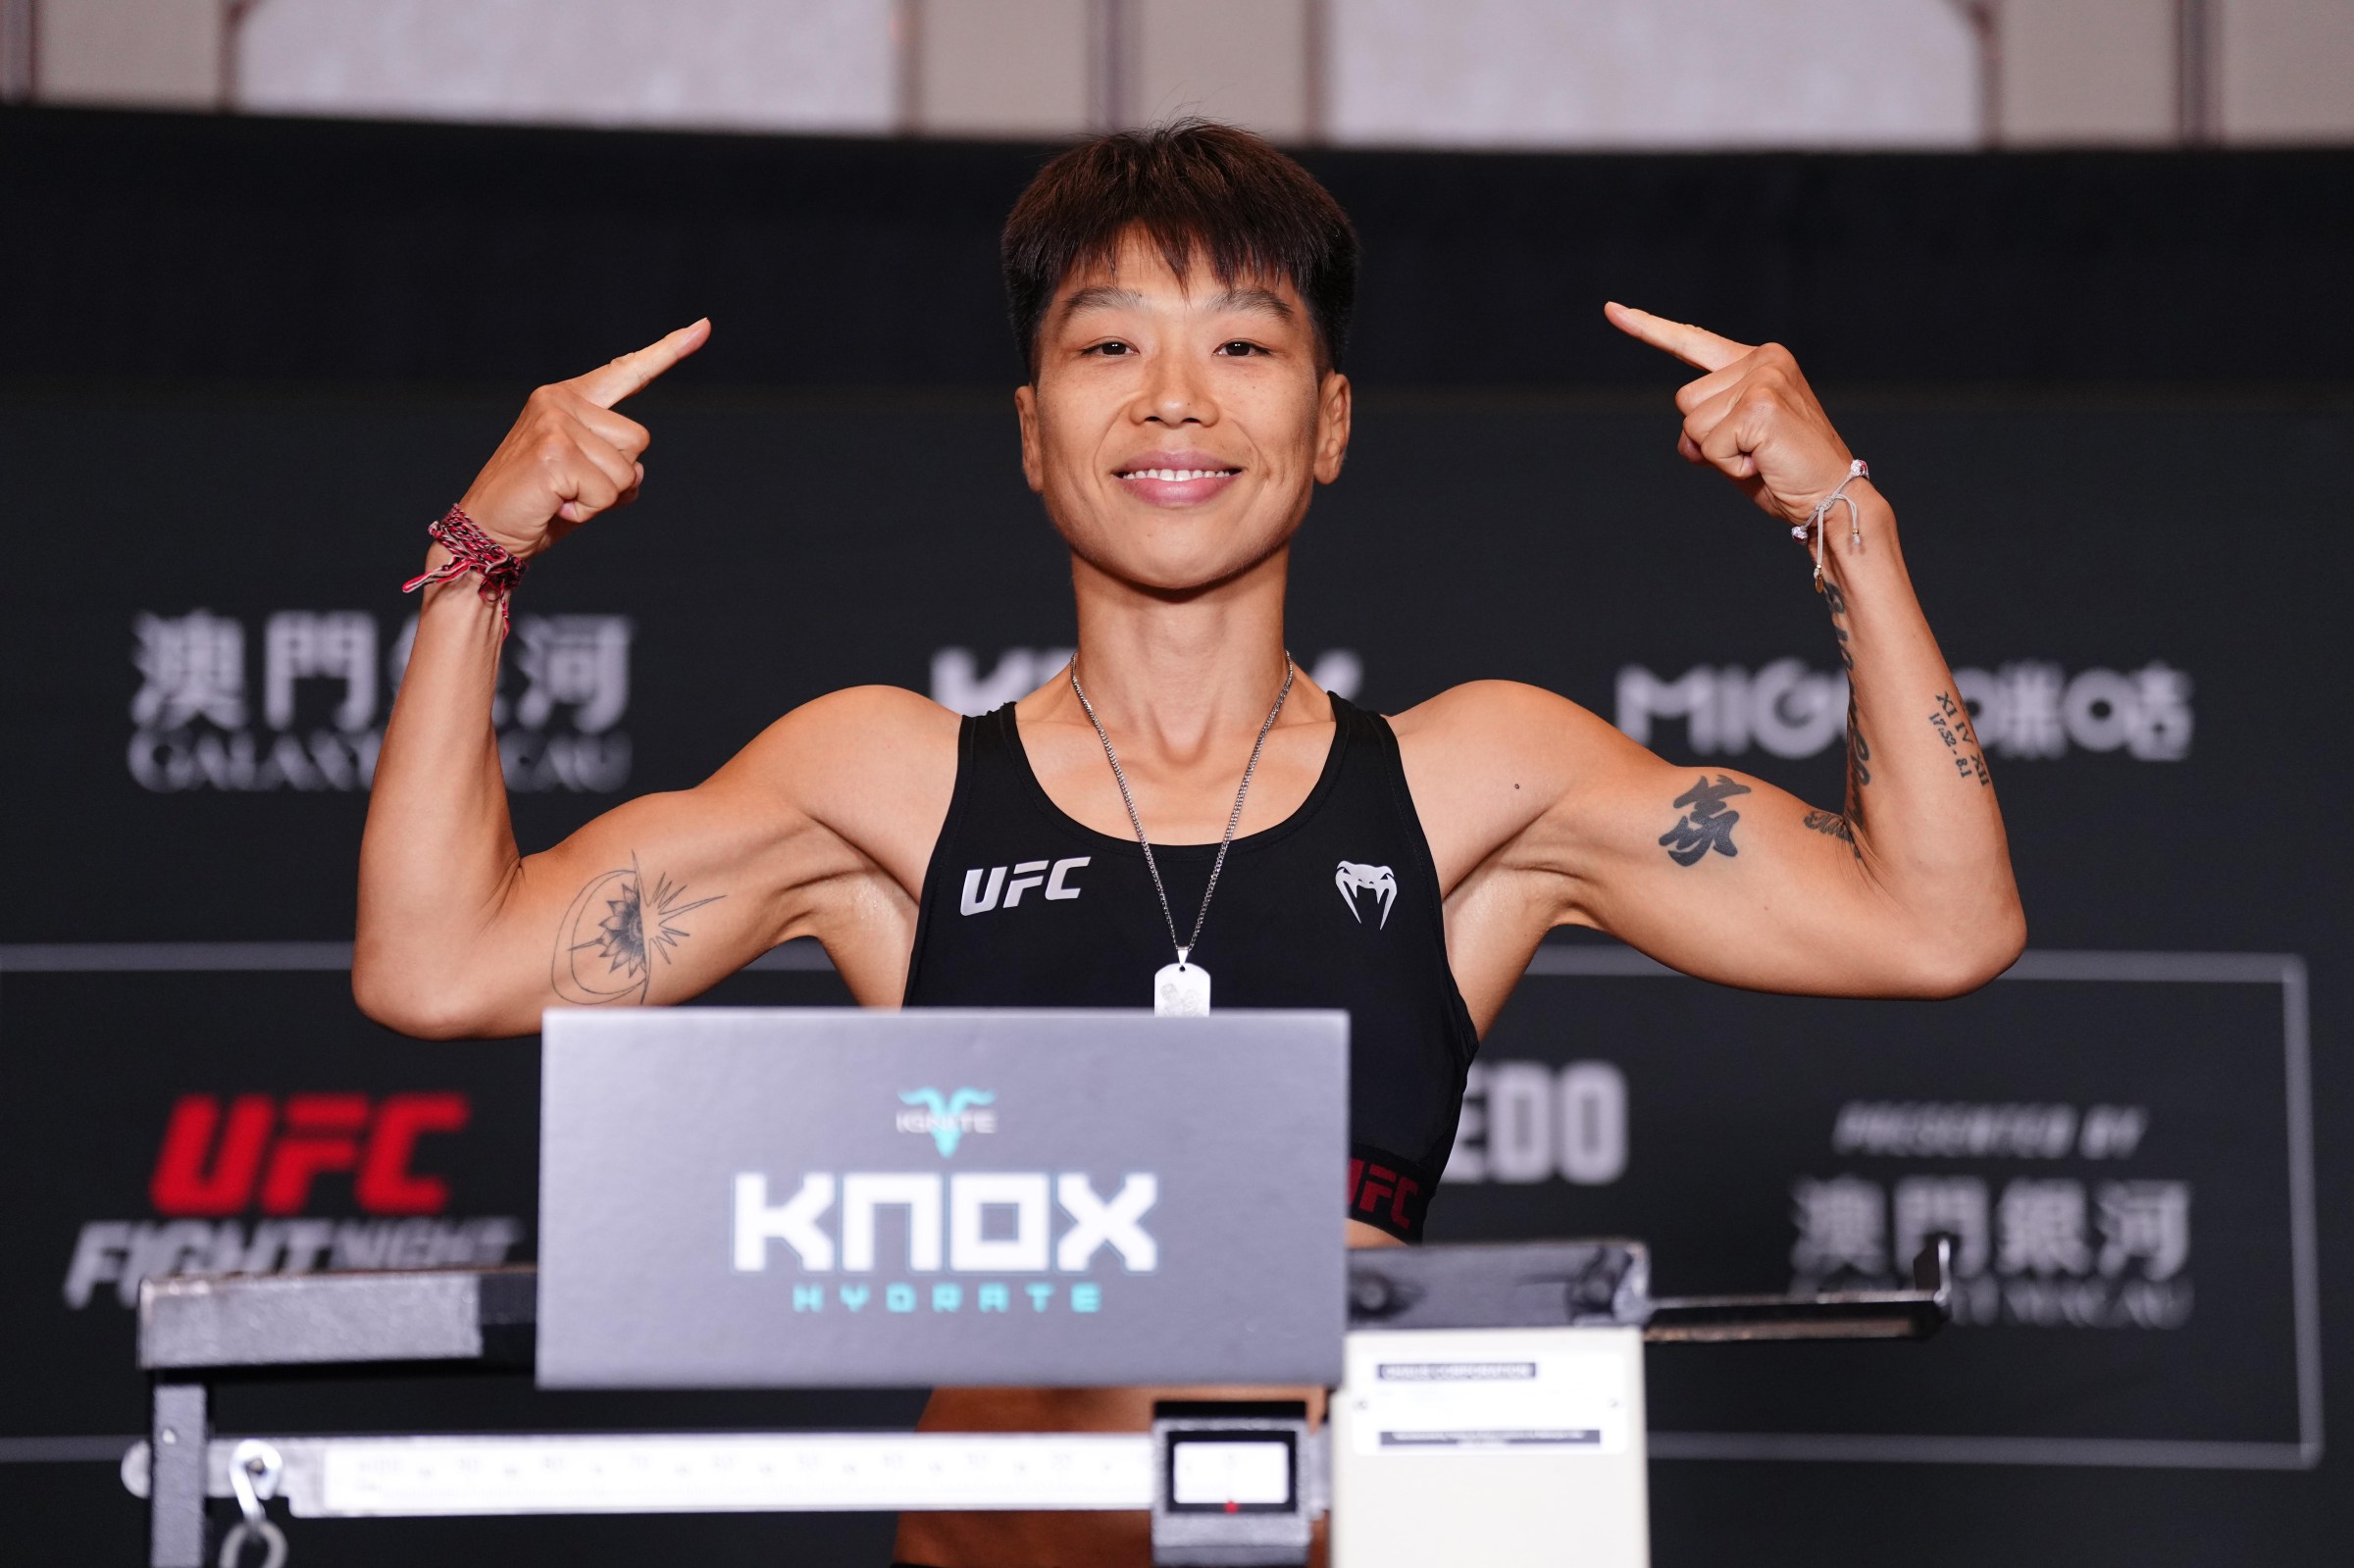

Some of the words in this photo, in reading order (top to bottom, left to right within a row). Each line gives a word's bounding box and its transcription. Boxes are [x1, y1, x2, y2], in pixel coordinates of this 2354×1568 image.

[1935, 691, 1958, 718] XI
[1955, 721, 1974, 744] IV
[1970, 752, 1990, 786] XII
[959, 856, 1092, 917] UFC
[147, 1091, 471, 1217] UFC
[793, 1283, 1102, 1313] HYDRATE
